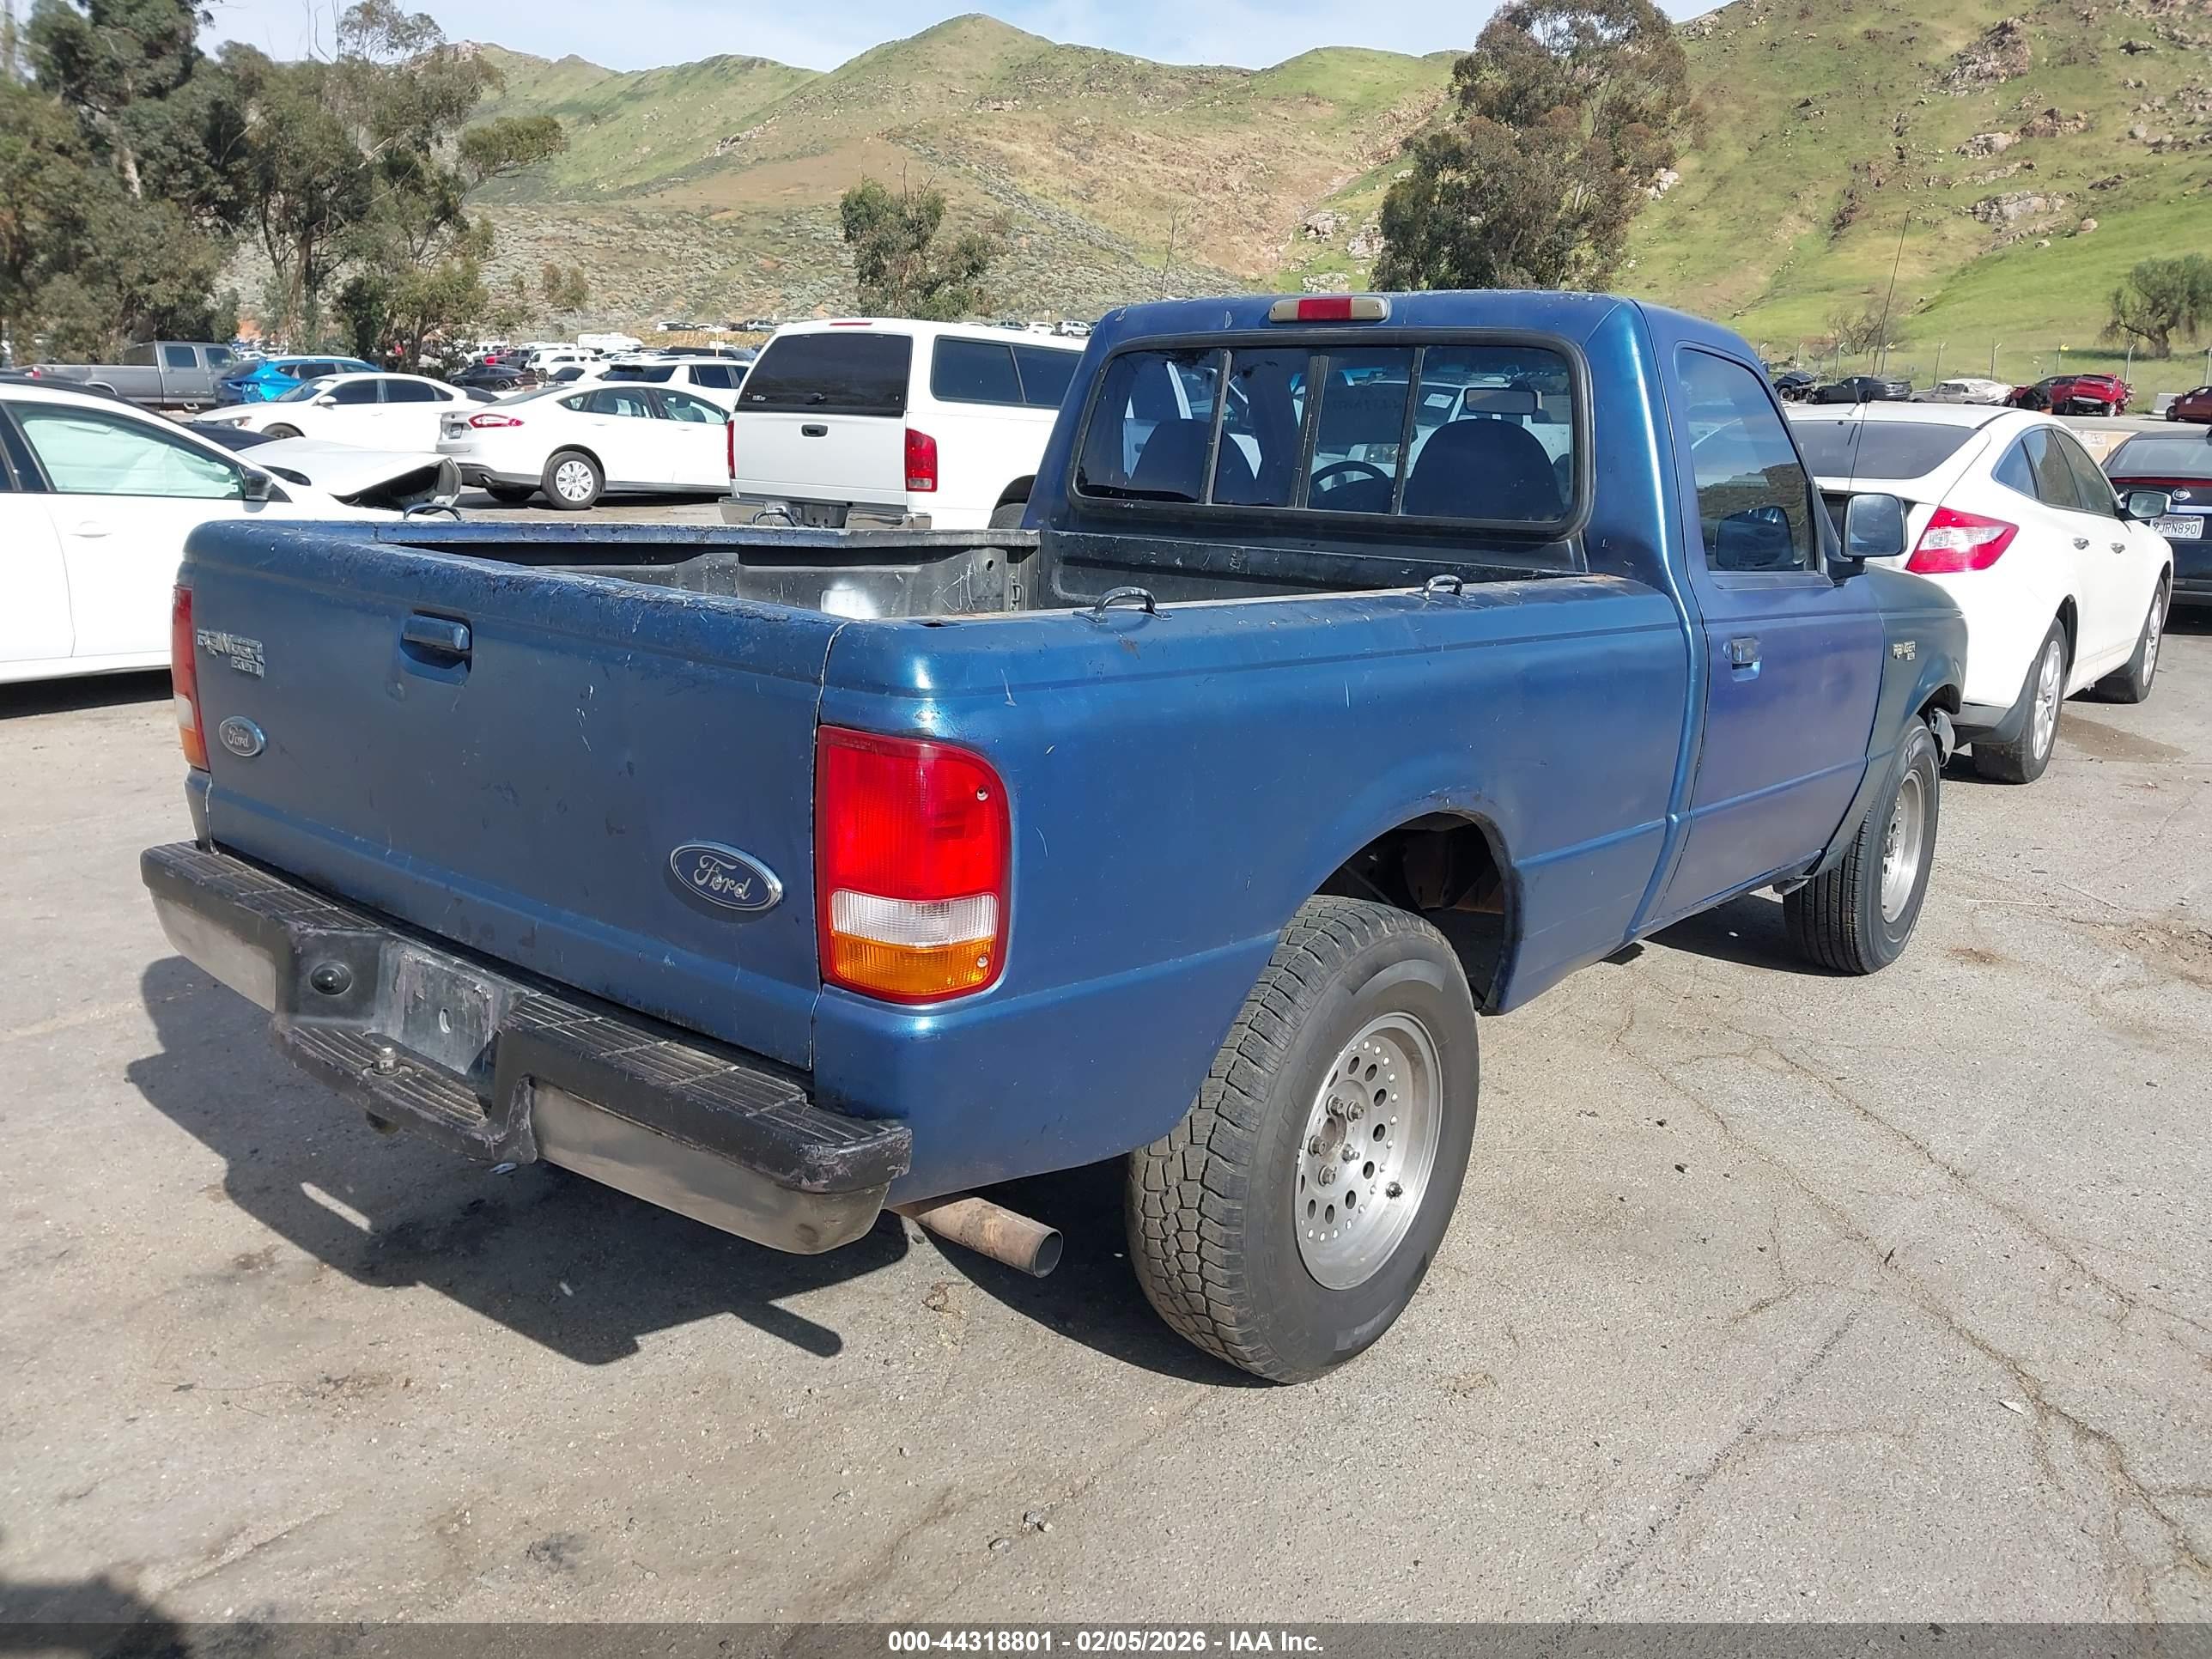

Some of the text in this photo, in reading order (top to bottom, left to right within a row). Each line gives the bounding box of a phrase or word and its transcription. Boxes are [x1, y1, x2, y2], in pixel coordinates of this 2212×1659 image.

[2154, 521, 2197, 534] 9JRN890
[228, 726, 250, 748] Ford
[693, 854, 752, 900] Ford
